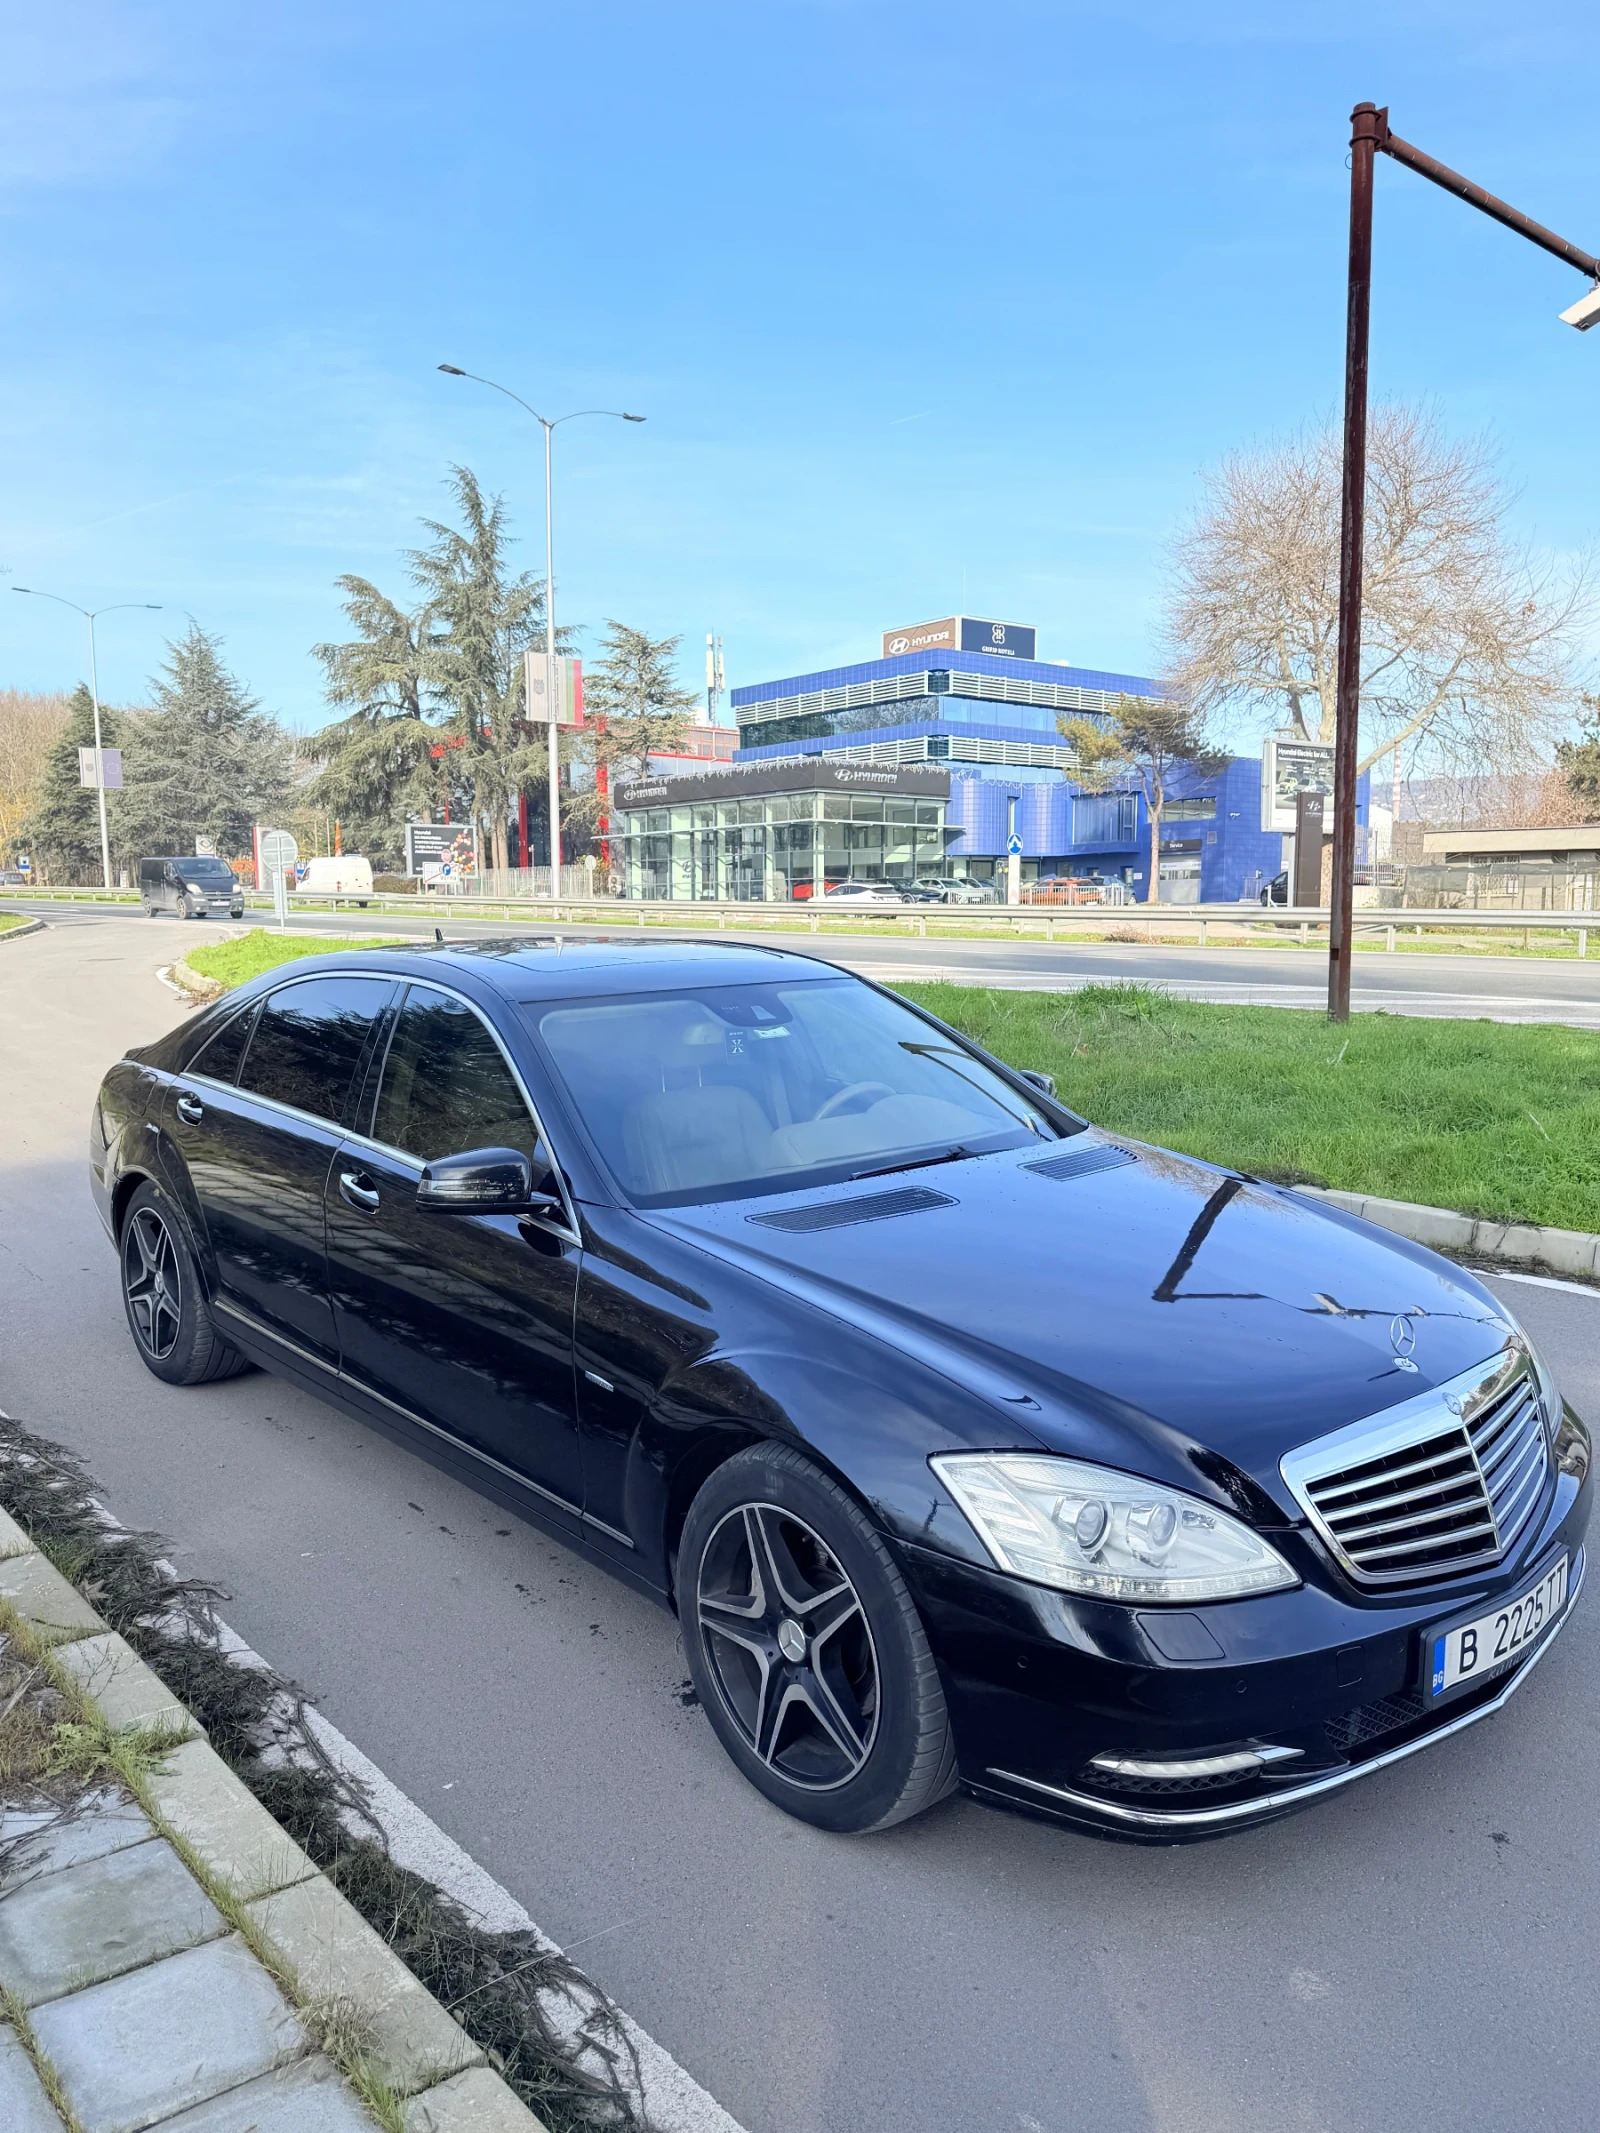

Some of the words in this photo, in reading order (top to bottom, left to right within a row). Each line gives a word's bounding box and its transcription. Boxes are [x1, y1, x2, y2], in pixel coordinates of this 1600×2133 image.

[912, 631, 949, 647] HYUNDAI
[1278, 747, 1297, 756] Hyundai
[1297, 749, 1313, 758] Electric
[853, 771, 898, 784] HYUNDAI
[636, 786, 667, 798] HYUNDAI
[1459, 1629, 1478, 1674] B
[1494, 1585, 1543, 1659] 2225
[1547, 1561, 1565, 1614] TT
[1433, 1671, 1443, 1687] BG
